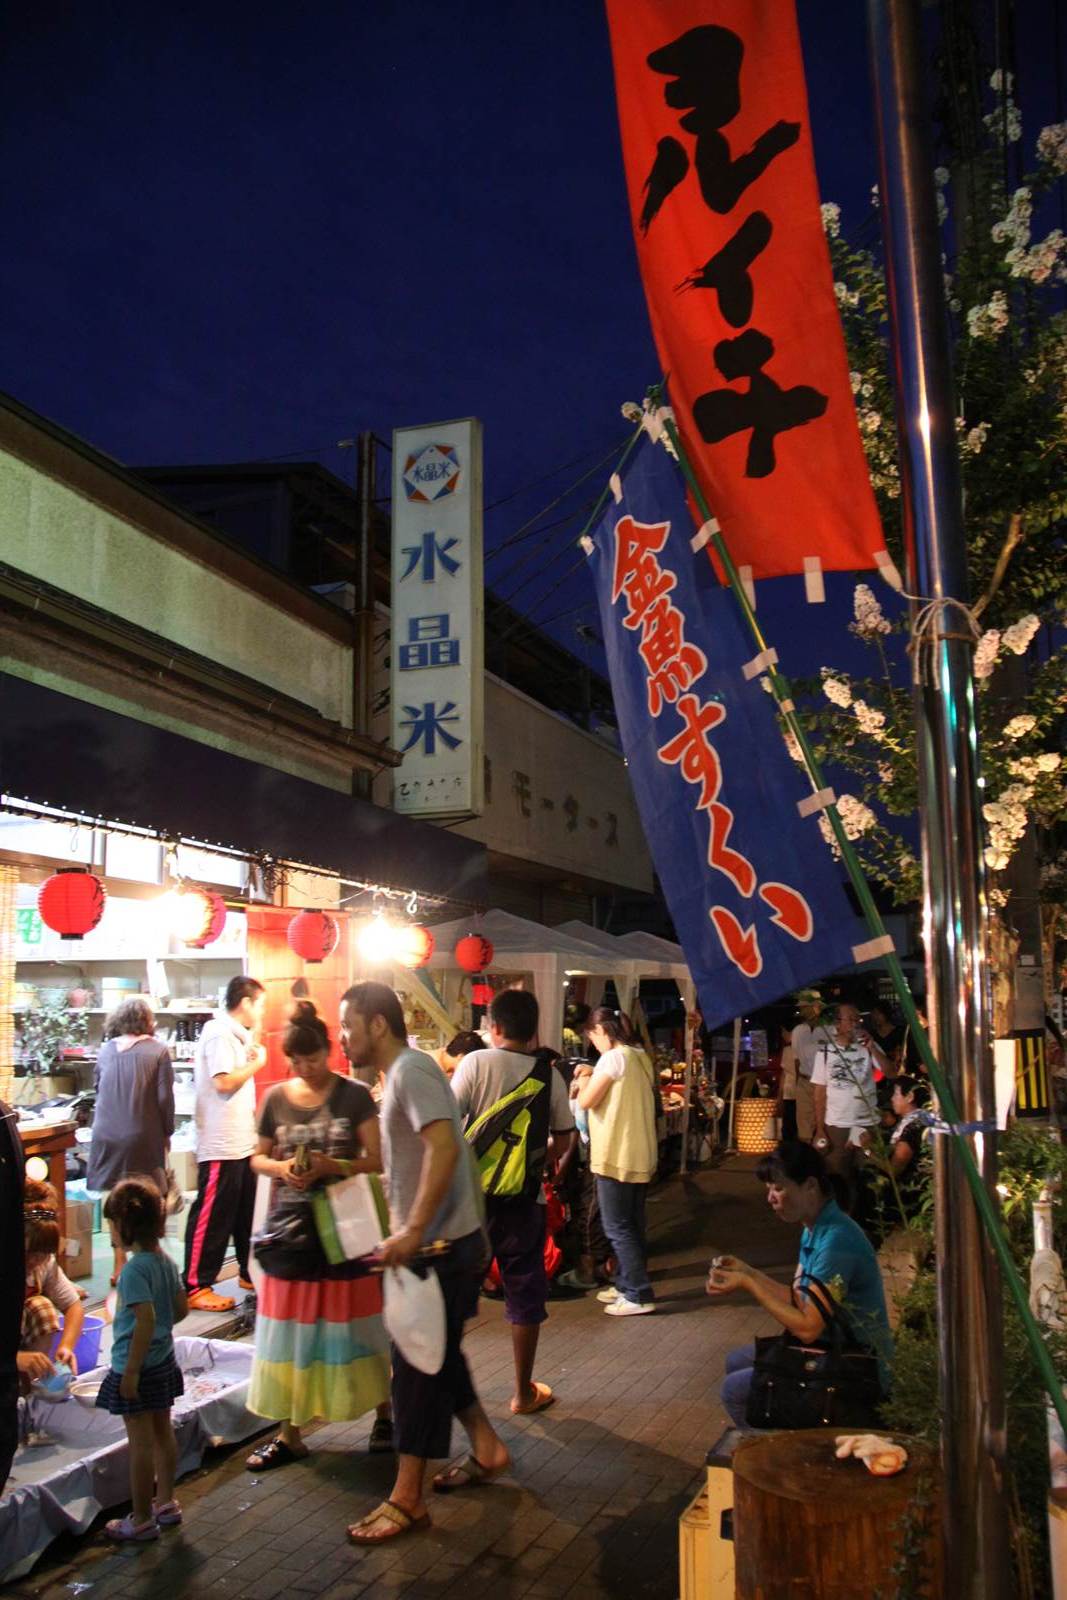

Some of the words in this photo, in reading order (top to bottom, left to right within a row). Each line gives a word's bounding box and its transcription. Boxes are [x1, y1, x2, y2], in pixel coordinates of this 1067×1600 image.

[640, 24, 829, 479] ヨルイチ
[413, 463, 450, 482] 水晶米
[398, 531, 463, 755] 水晶米
[612, 515, 814, 979] 金魚すくい
